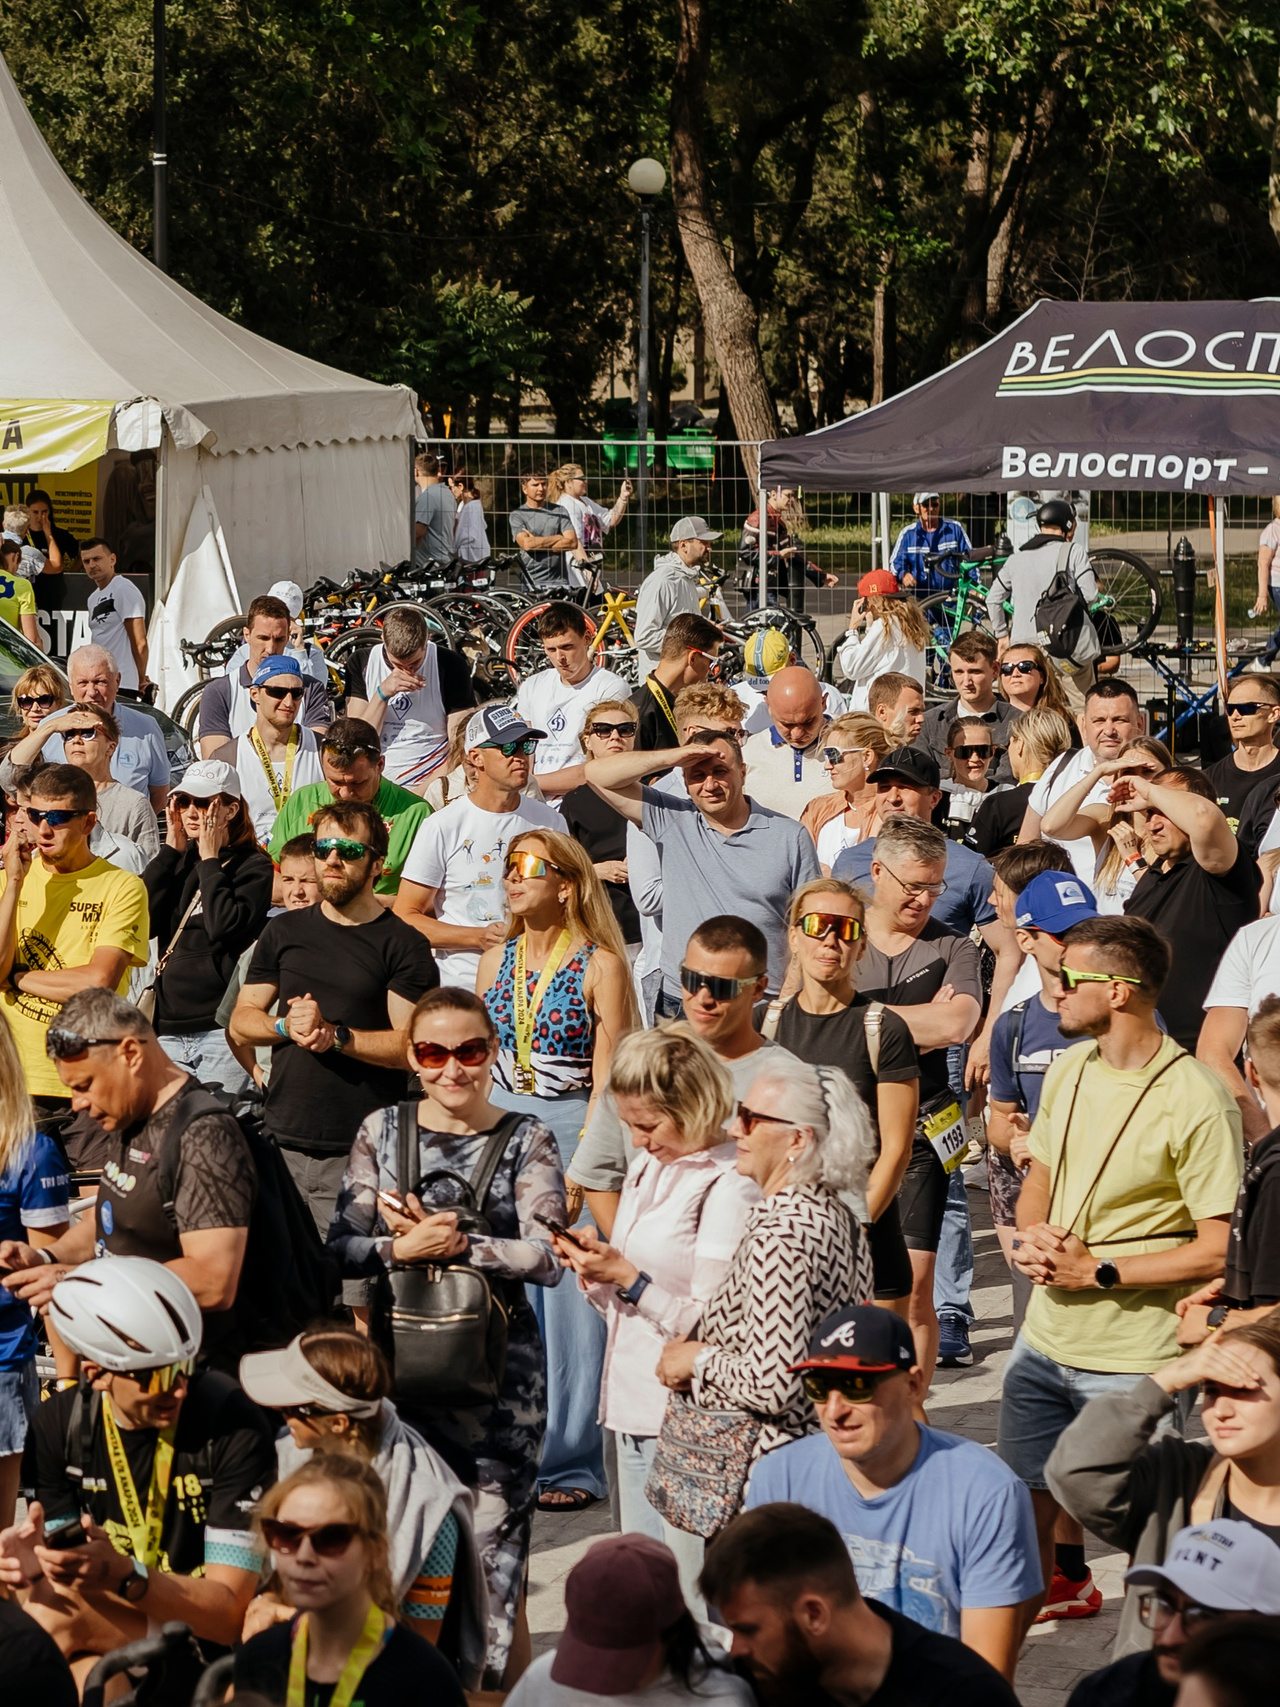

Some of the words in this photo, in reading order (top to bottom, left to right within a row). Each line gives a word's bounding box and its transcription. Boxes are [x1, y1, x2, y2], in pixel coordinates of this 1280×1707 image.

[1001, 446, 1237, 490] Велоспорт
[869, 584, 878, 593] 13
[941, 1124, 964, 1155] 1193
[40, 1176, 55, 1189] TRI
[128, 1504, 141, 1529] 2024
